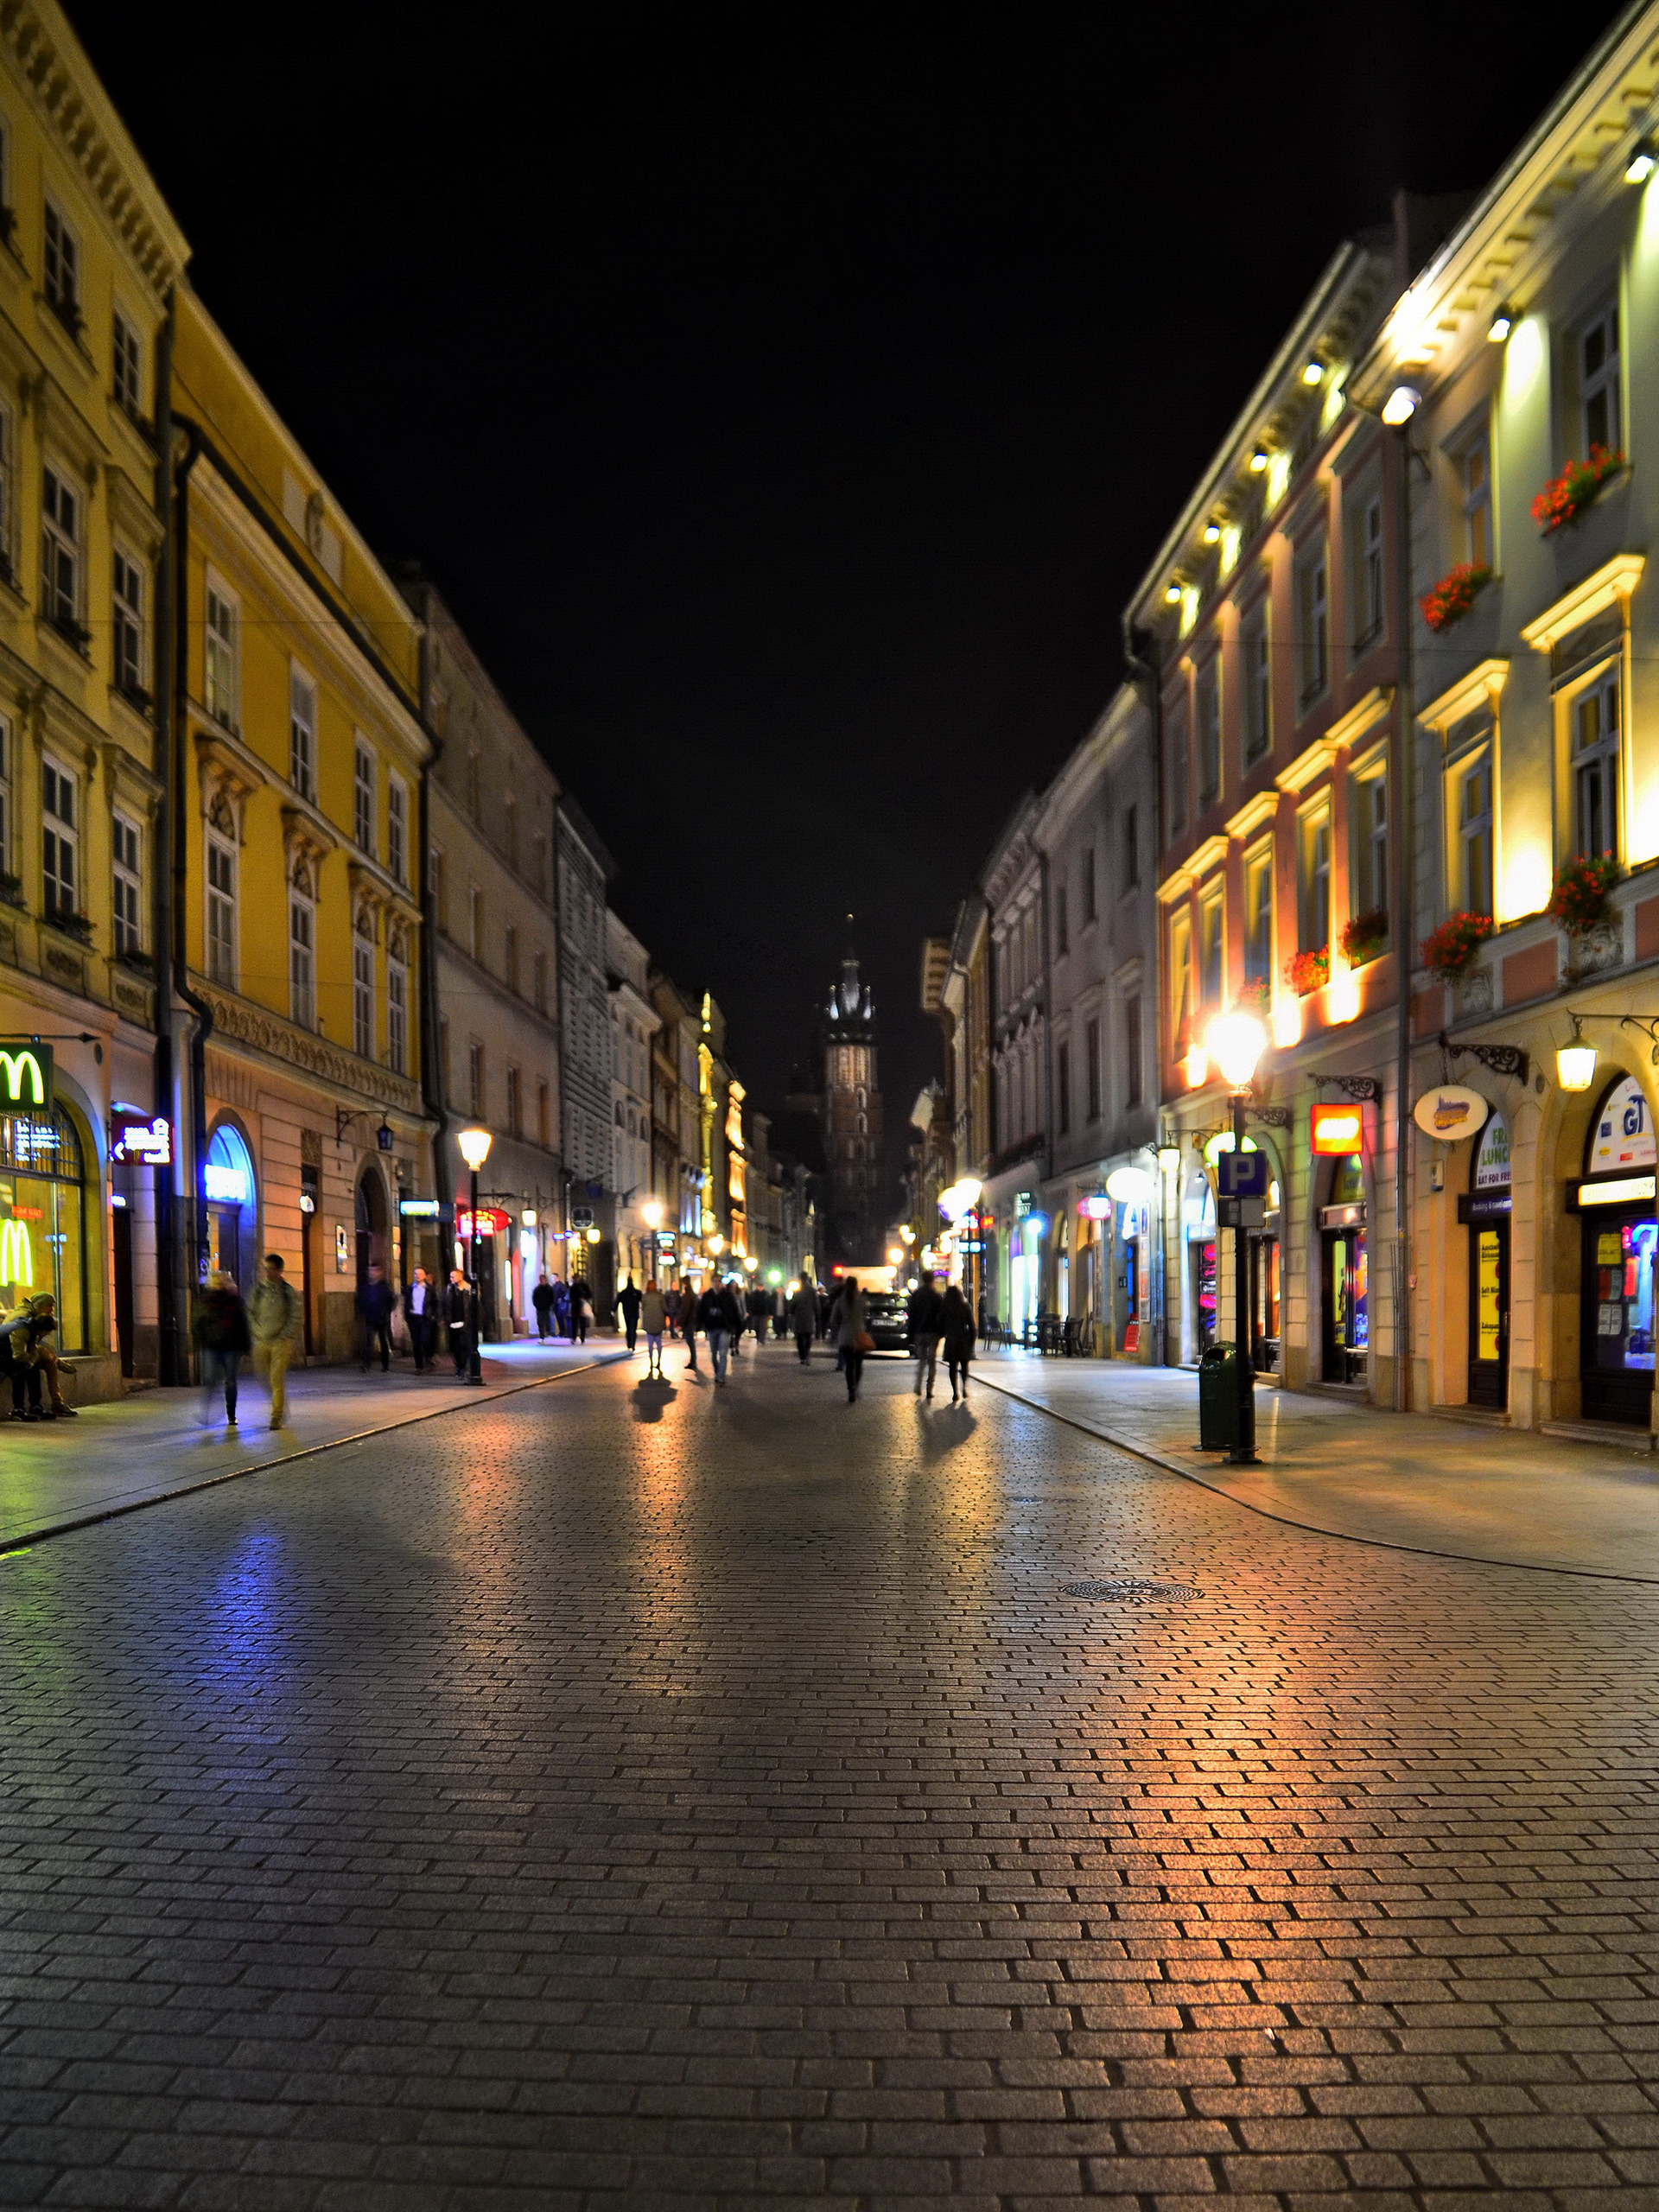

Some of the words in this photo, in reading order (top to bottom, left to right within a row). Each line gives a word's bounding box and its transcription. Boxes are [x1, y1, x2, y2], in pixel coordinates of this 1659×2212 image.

[1482, 1145, 1510, 1166] LUNC
[1230, 1154, 1255, 1190] P
[1489, 1173, 1499, 1183] FOR
